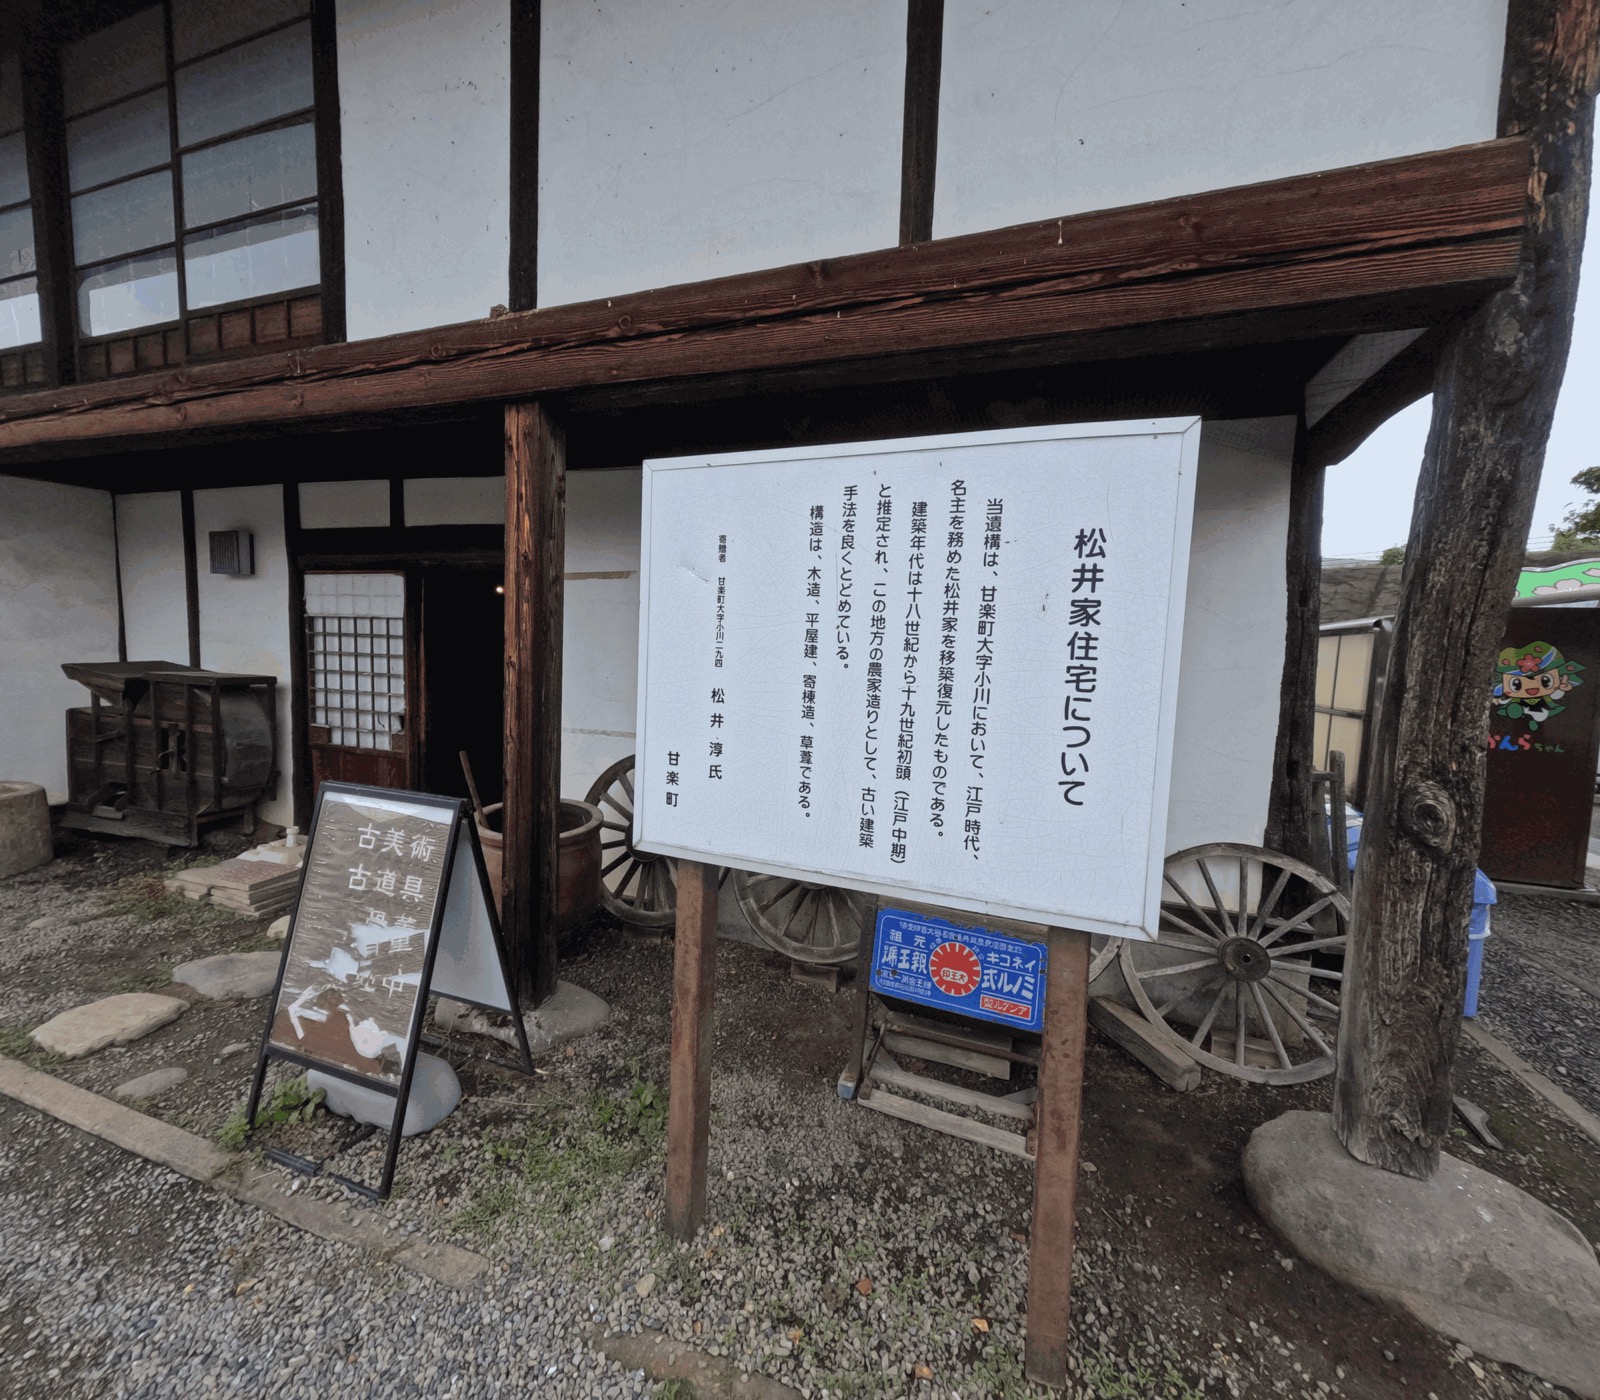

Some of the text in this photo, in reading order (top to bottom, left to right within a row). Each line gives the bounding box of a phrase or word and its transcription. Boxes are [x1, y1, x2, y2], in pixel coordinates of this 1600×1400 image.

[835, 484, 858, 670] 手法を良くとどめている。
[858, 483, 892, 849] と推定され、この地方の農家造りとして、古い建築
[930, 479, 967, 837] 名主を務めた松井家を移築復元したものである。
[1058, 528, 1107, 806] 松井家住宅について
[358, 823, 437, 862] 古美術
[665, 750, 681, 808] 甘楽町
[348, 864, 424, 903] 古道具
